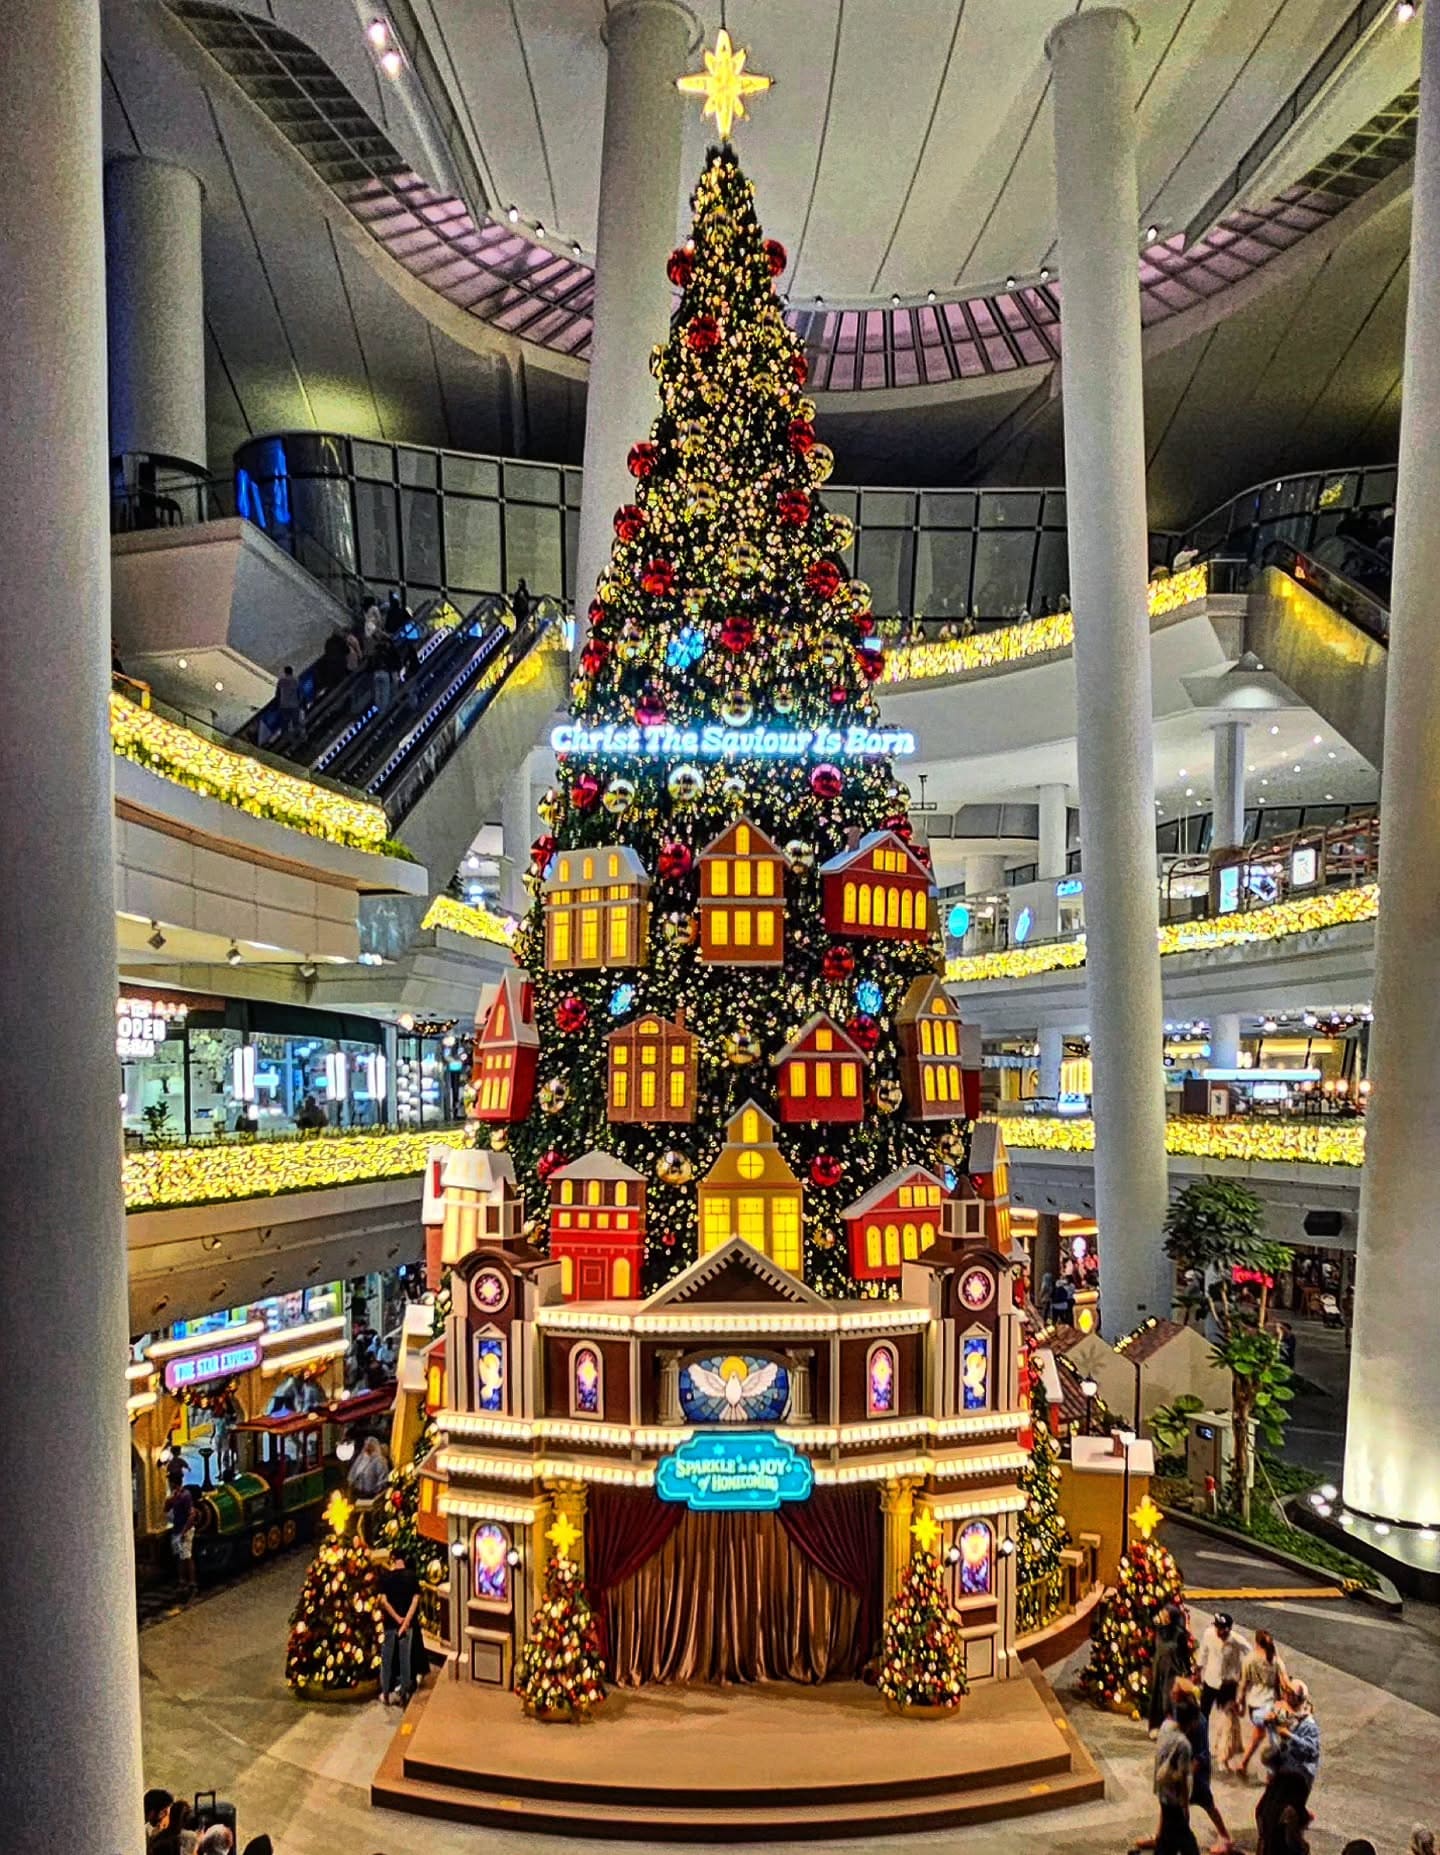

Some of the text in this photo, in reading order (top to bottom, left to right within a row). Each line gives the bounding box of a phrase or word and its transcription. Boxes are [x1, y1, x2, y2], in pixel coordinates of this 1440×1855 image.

[551, 722, 915, 755] Christ The Saviour Is Born
[118, 1017, 166, 1042] OPEN
[676, 1458, 736, 1478] SPARKLE
[758, 1458, 787, 1476] JOY
[711, 1475, 779, 1492] HOMECOMING
